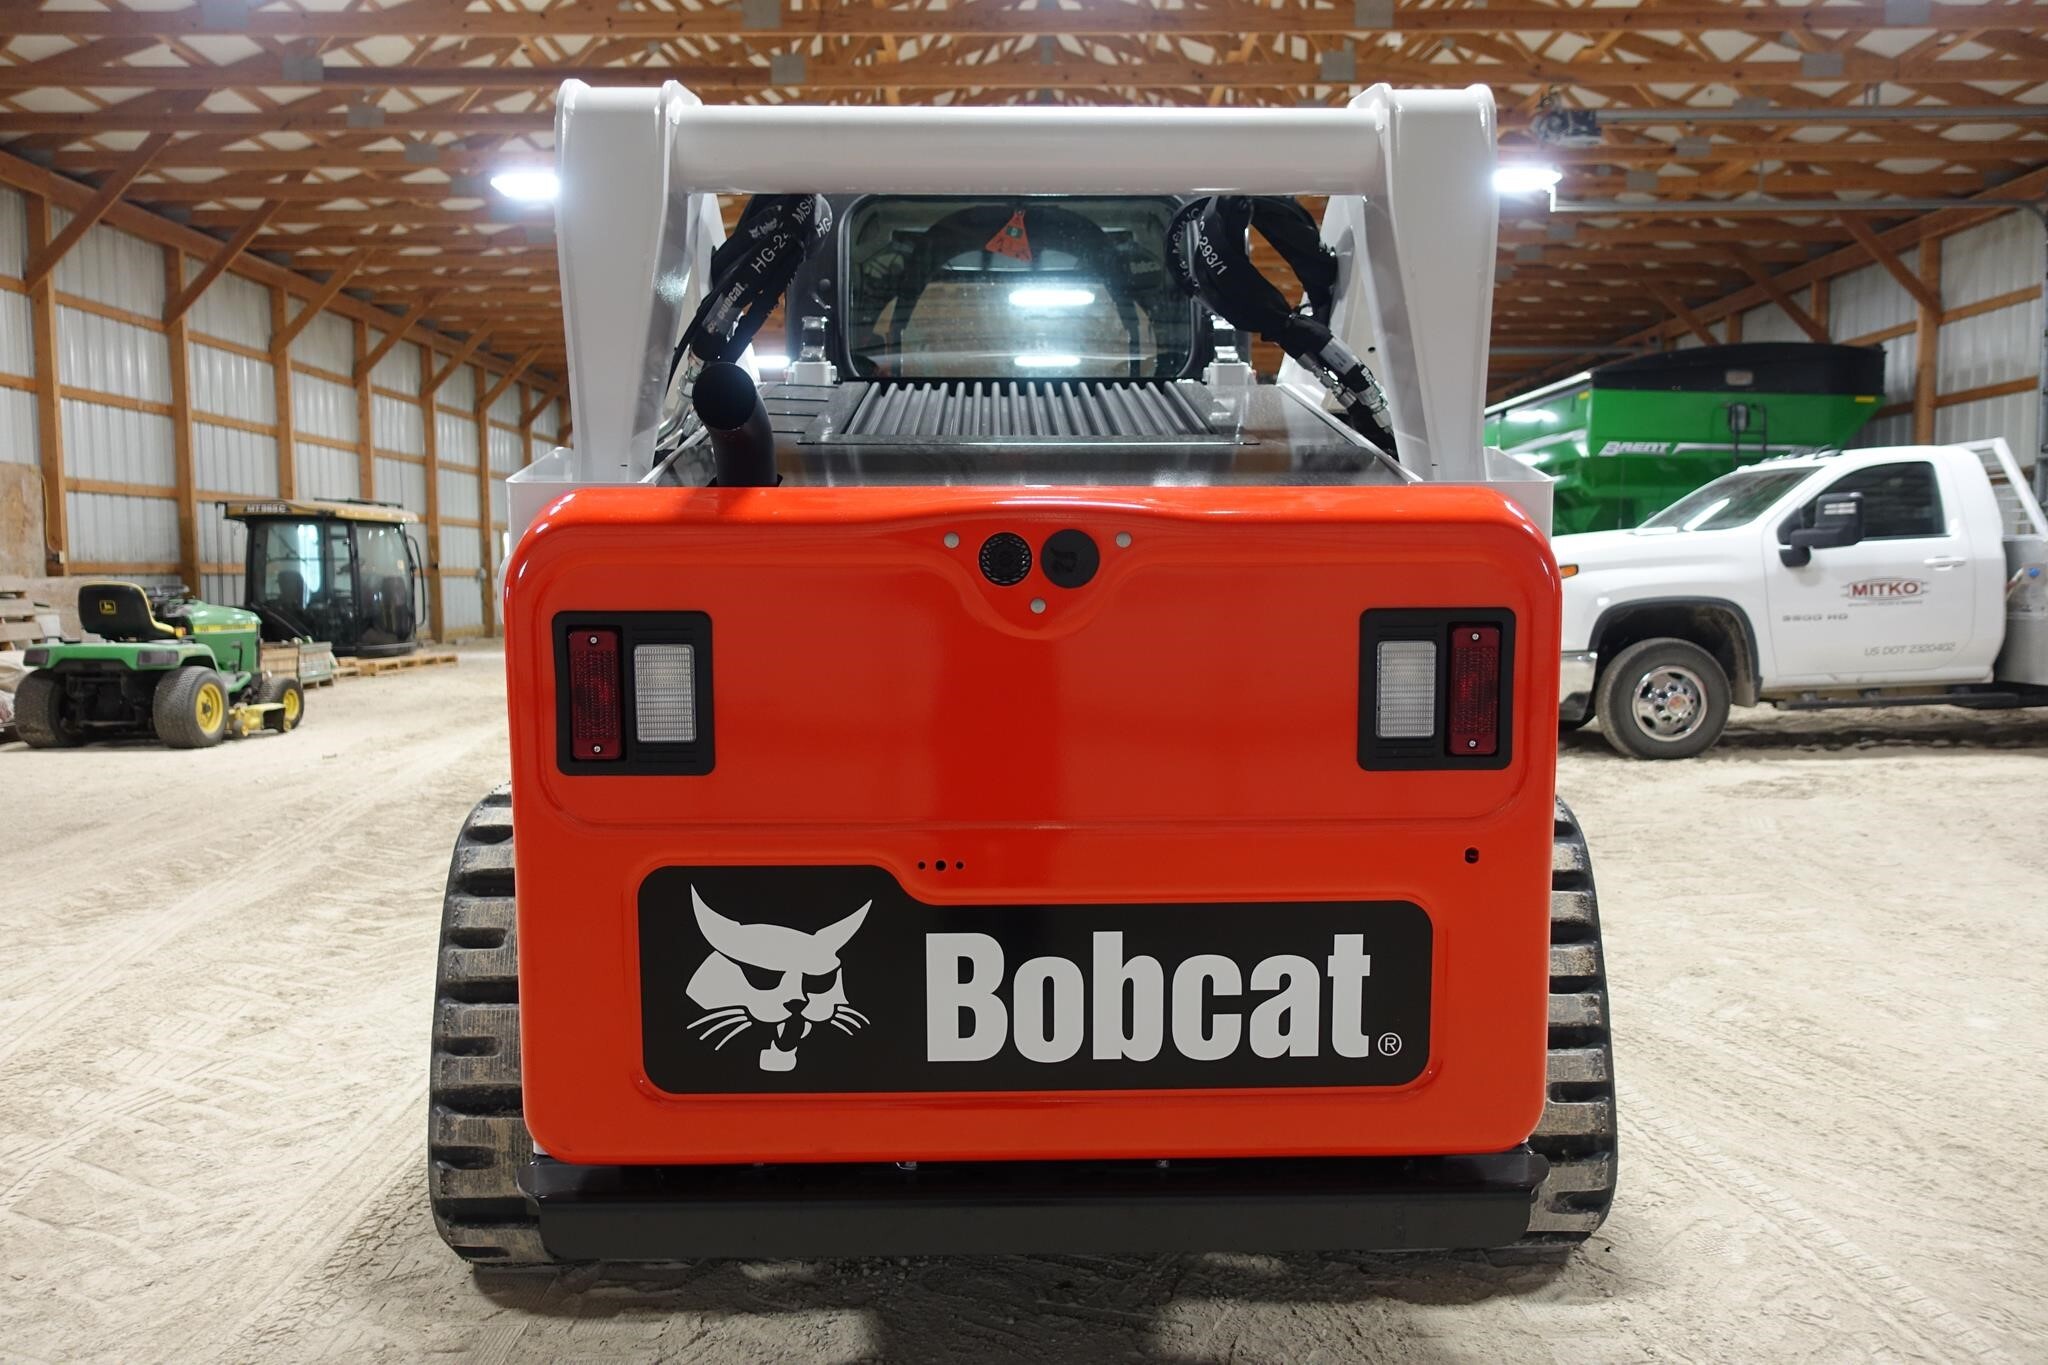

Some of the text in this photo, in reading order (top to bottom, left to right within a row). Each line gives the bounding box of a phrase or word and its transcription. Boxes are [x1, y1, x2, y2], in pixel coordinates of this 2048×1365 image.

[1598, 440, 1672, 457] BRENT
[1852, 582, 1919, 598] MITKO
[1864, 646, 1880, 657] US
[1882, 644, 1907, 656] DOT
[925, 930, 1371, 1064] Bobcat
